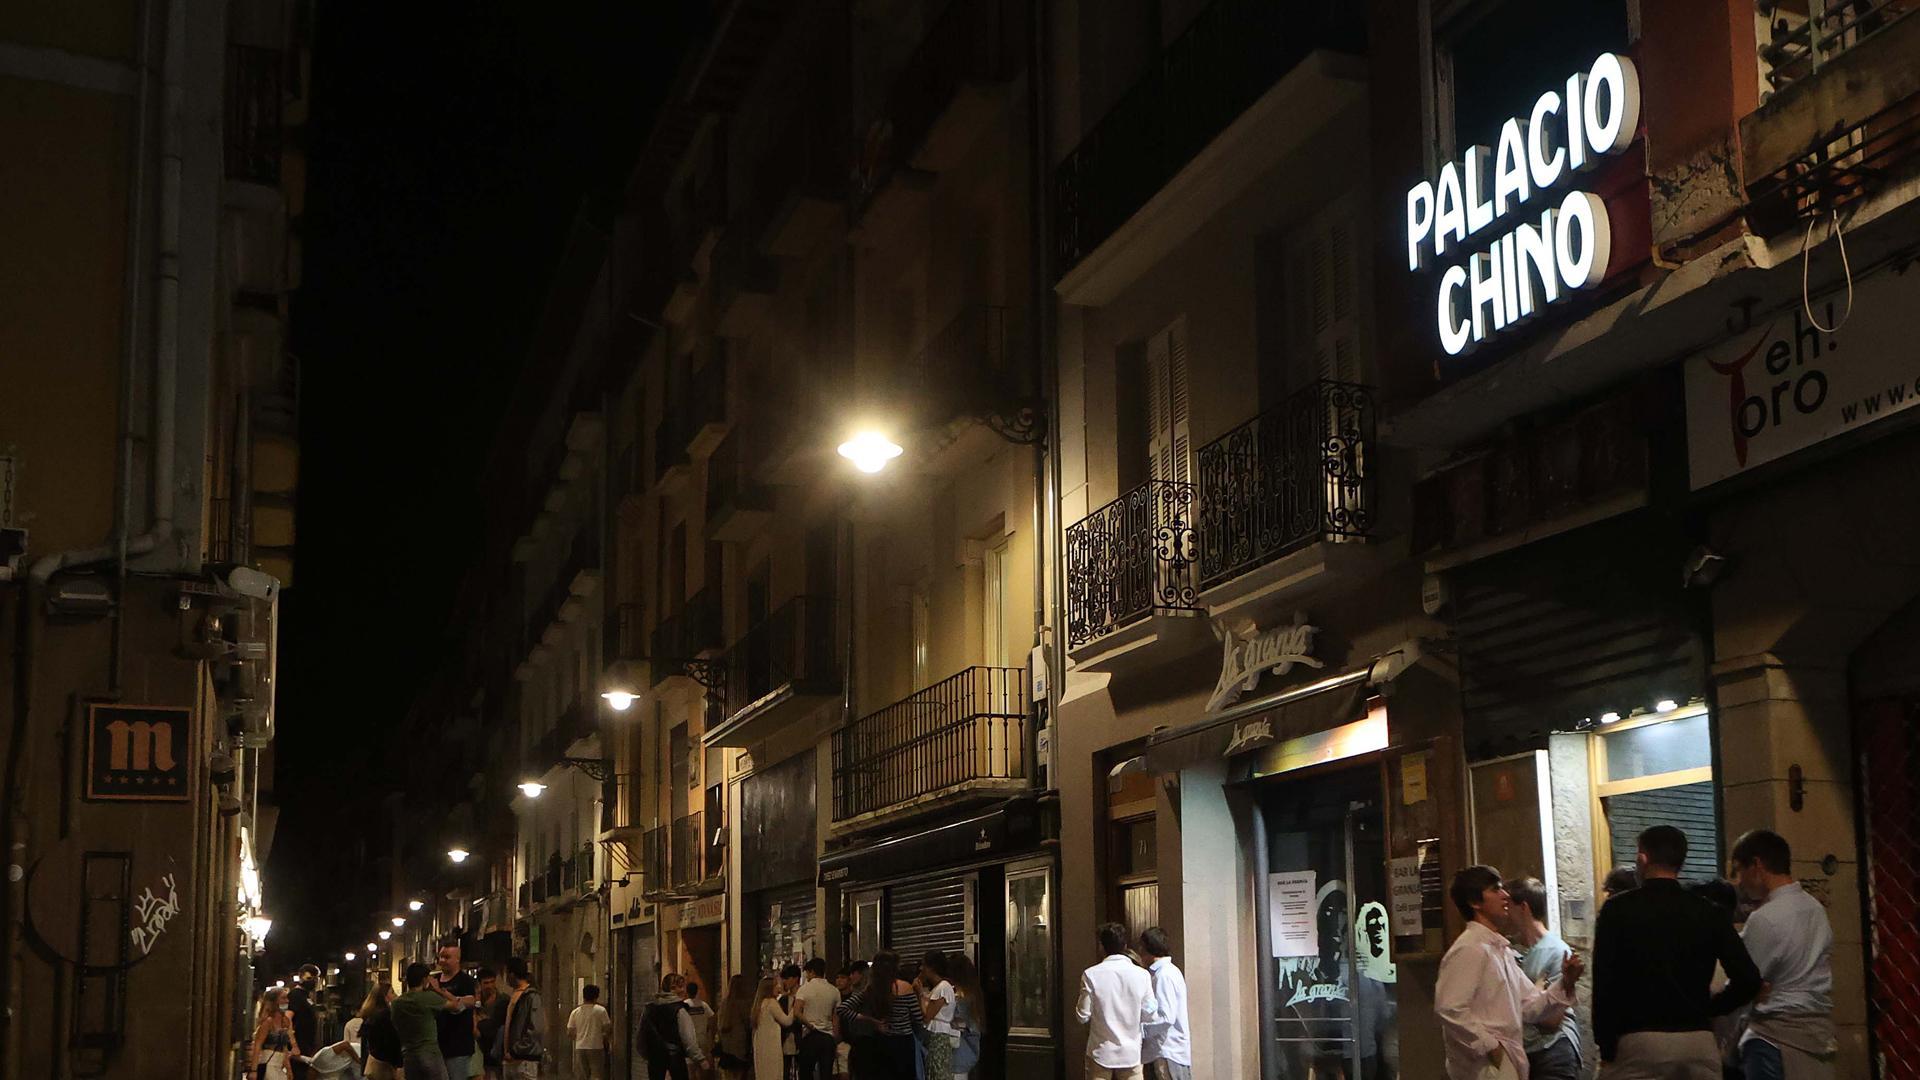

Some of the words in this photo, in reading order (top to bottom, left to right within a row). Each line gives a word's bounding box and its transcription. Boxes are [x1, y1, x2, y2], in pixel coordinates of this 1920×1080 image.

[1407, 51, 1633, 272] PALACIO
[1438, 190, 1604, 355] CHINO
[1766, 302, 1837, 375] eh!
